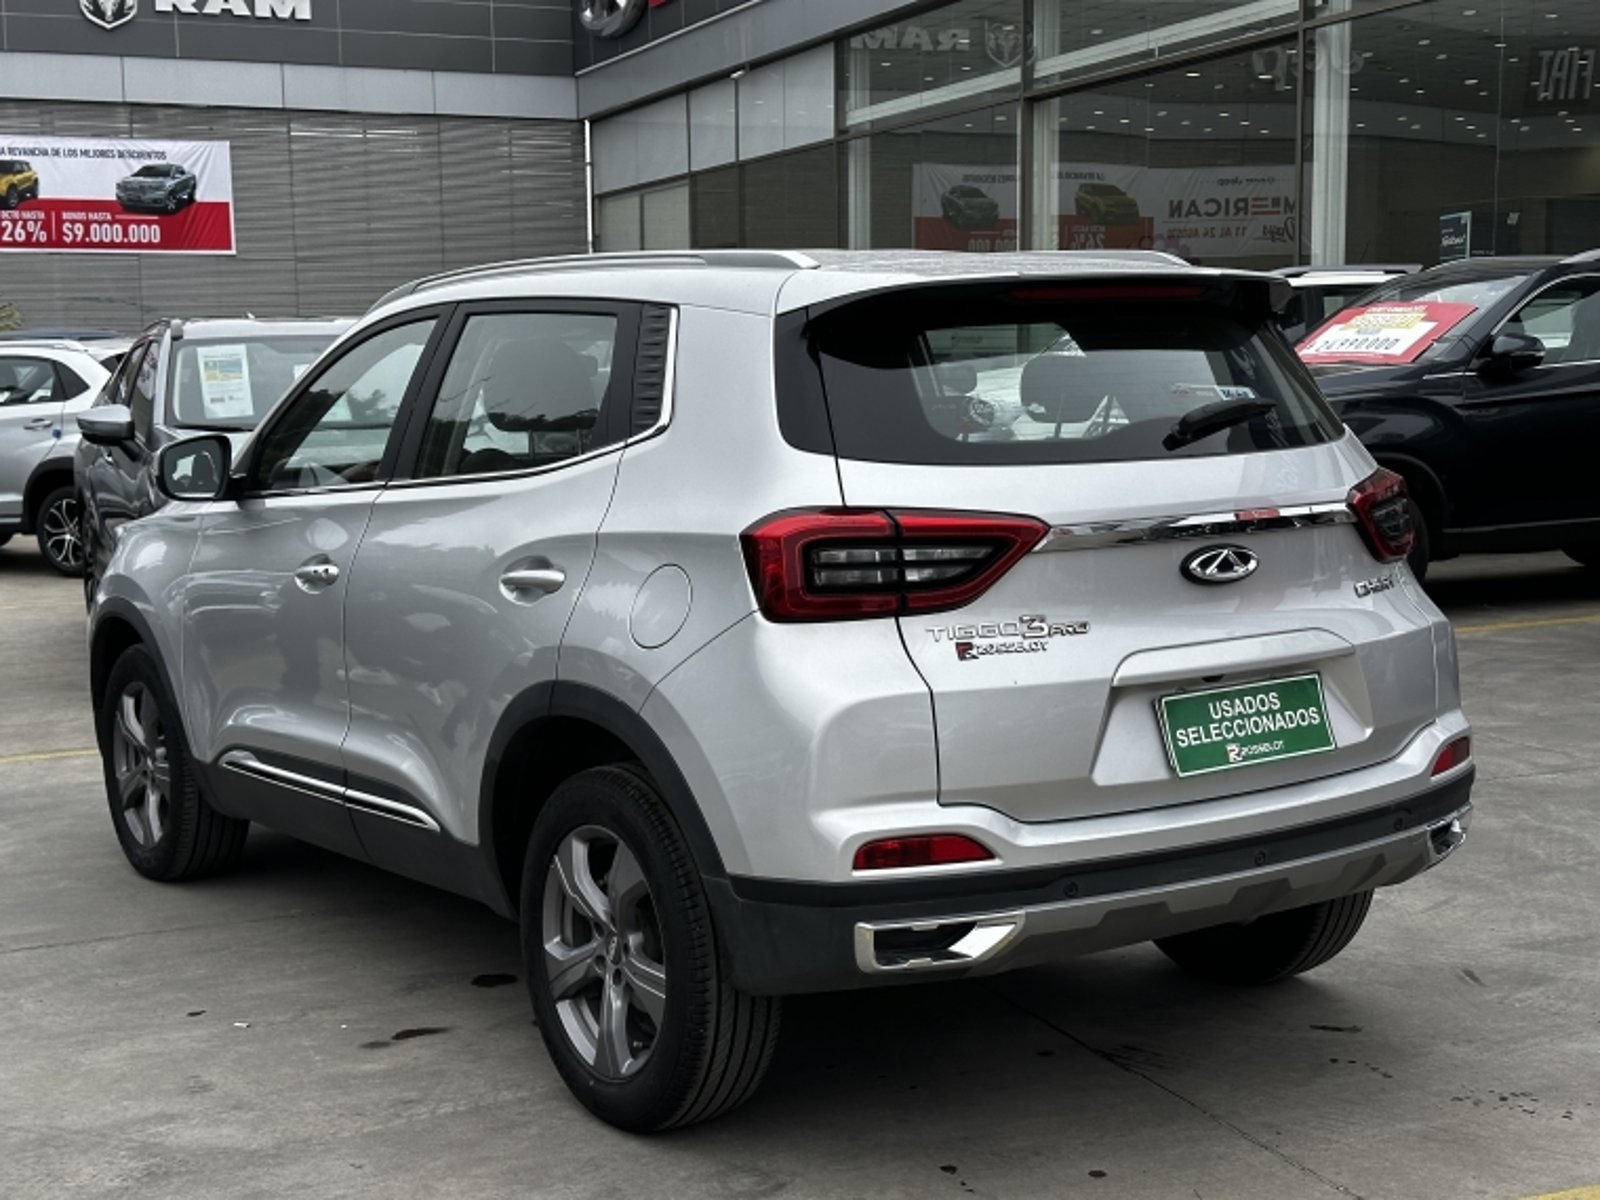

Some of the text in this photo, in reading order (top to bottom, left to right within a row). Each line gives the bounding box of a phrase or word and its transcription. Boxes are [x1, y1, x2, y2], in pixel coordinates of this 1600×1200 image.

[63, 149, 78, 158] LOS
[80, 149, 115, 159] MEJORES
[0, 220, 47, 243] 26%
[62, 222, 161, 244] $9.000.000
[1208, 691, 1281, 719] USADOS
[1176, 706, 1321, 747] SELECCIONADOS
